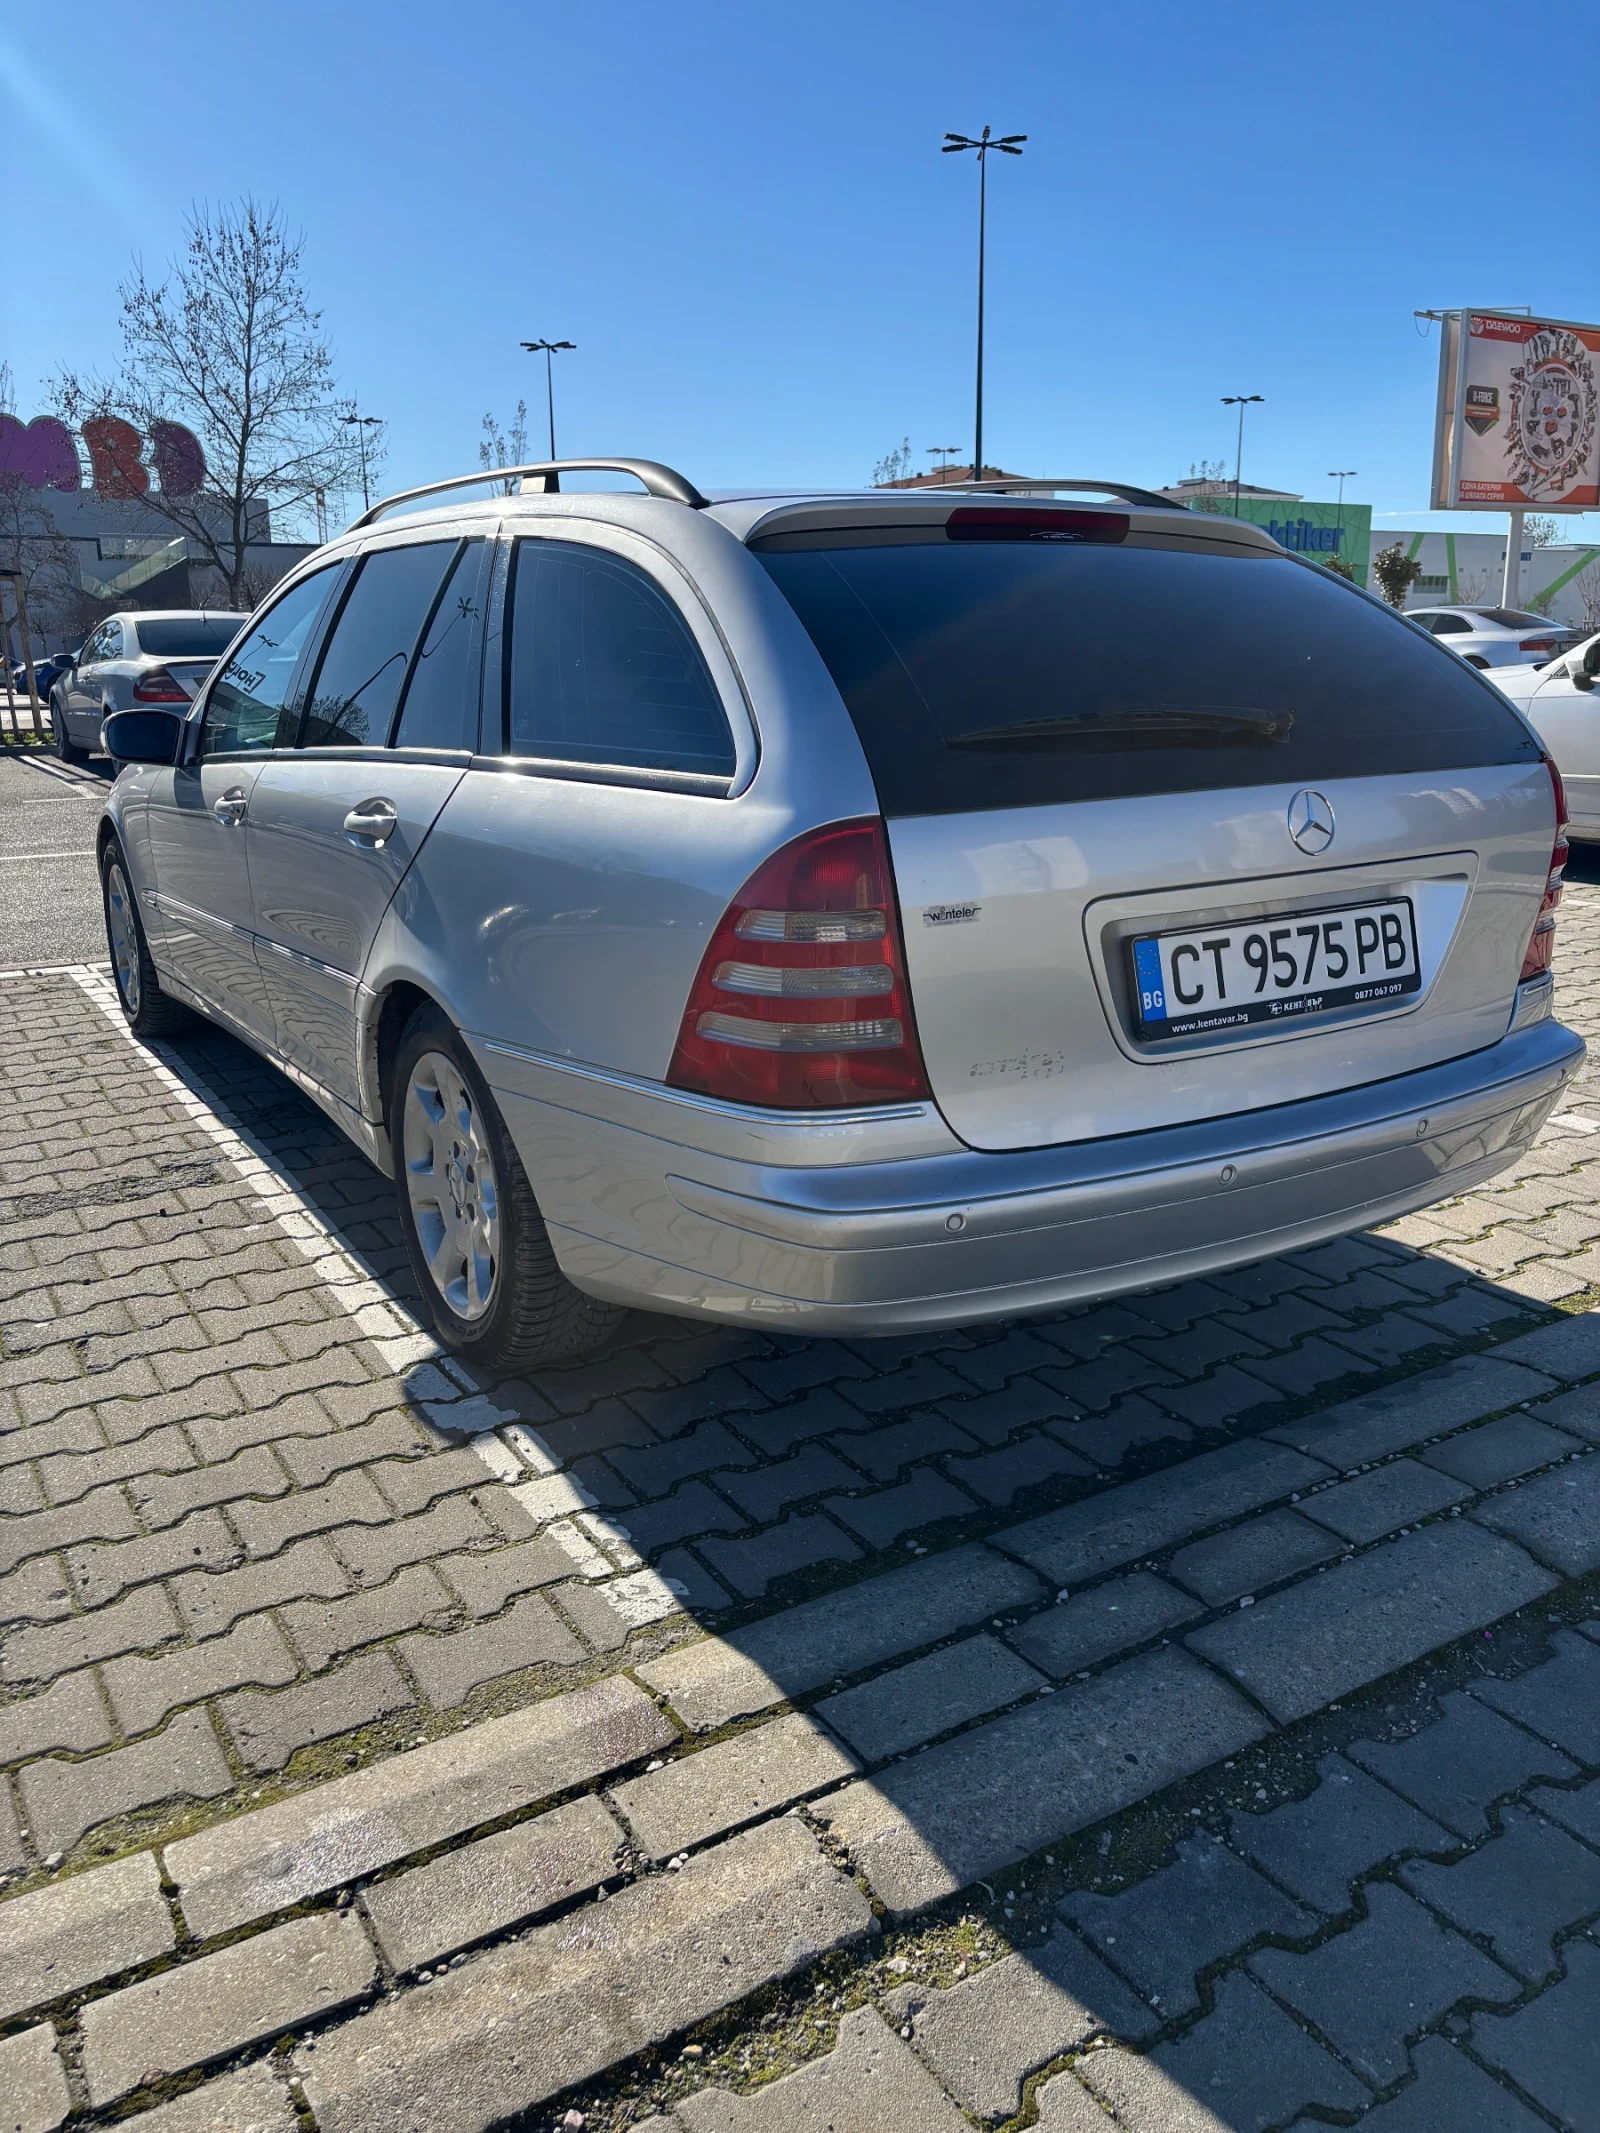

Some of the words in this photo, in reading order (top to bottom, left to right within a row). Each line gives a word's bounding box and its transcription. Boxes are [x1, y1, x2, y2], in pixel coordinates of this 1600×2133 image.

[1486, 321, 1521, 333] DAEWOO
[1257, 518, 1345, 552] ktiker
[1170, 938, 1231, 1005] CT
[1243, 921, 1349, 994] 9575
[1355, 913, 1407, 975] PB
[1142, 990, 1163, 1010] BG
[1354, 989, 1373, 1000] 0877
[1374, 986, 1388, 996] 067
[1389, 983, 1402, 993] 097
[1172, 1013, 1249, 1033] www.kentavar.bg
